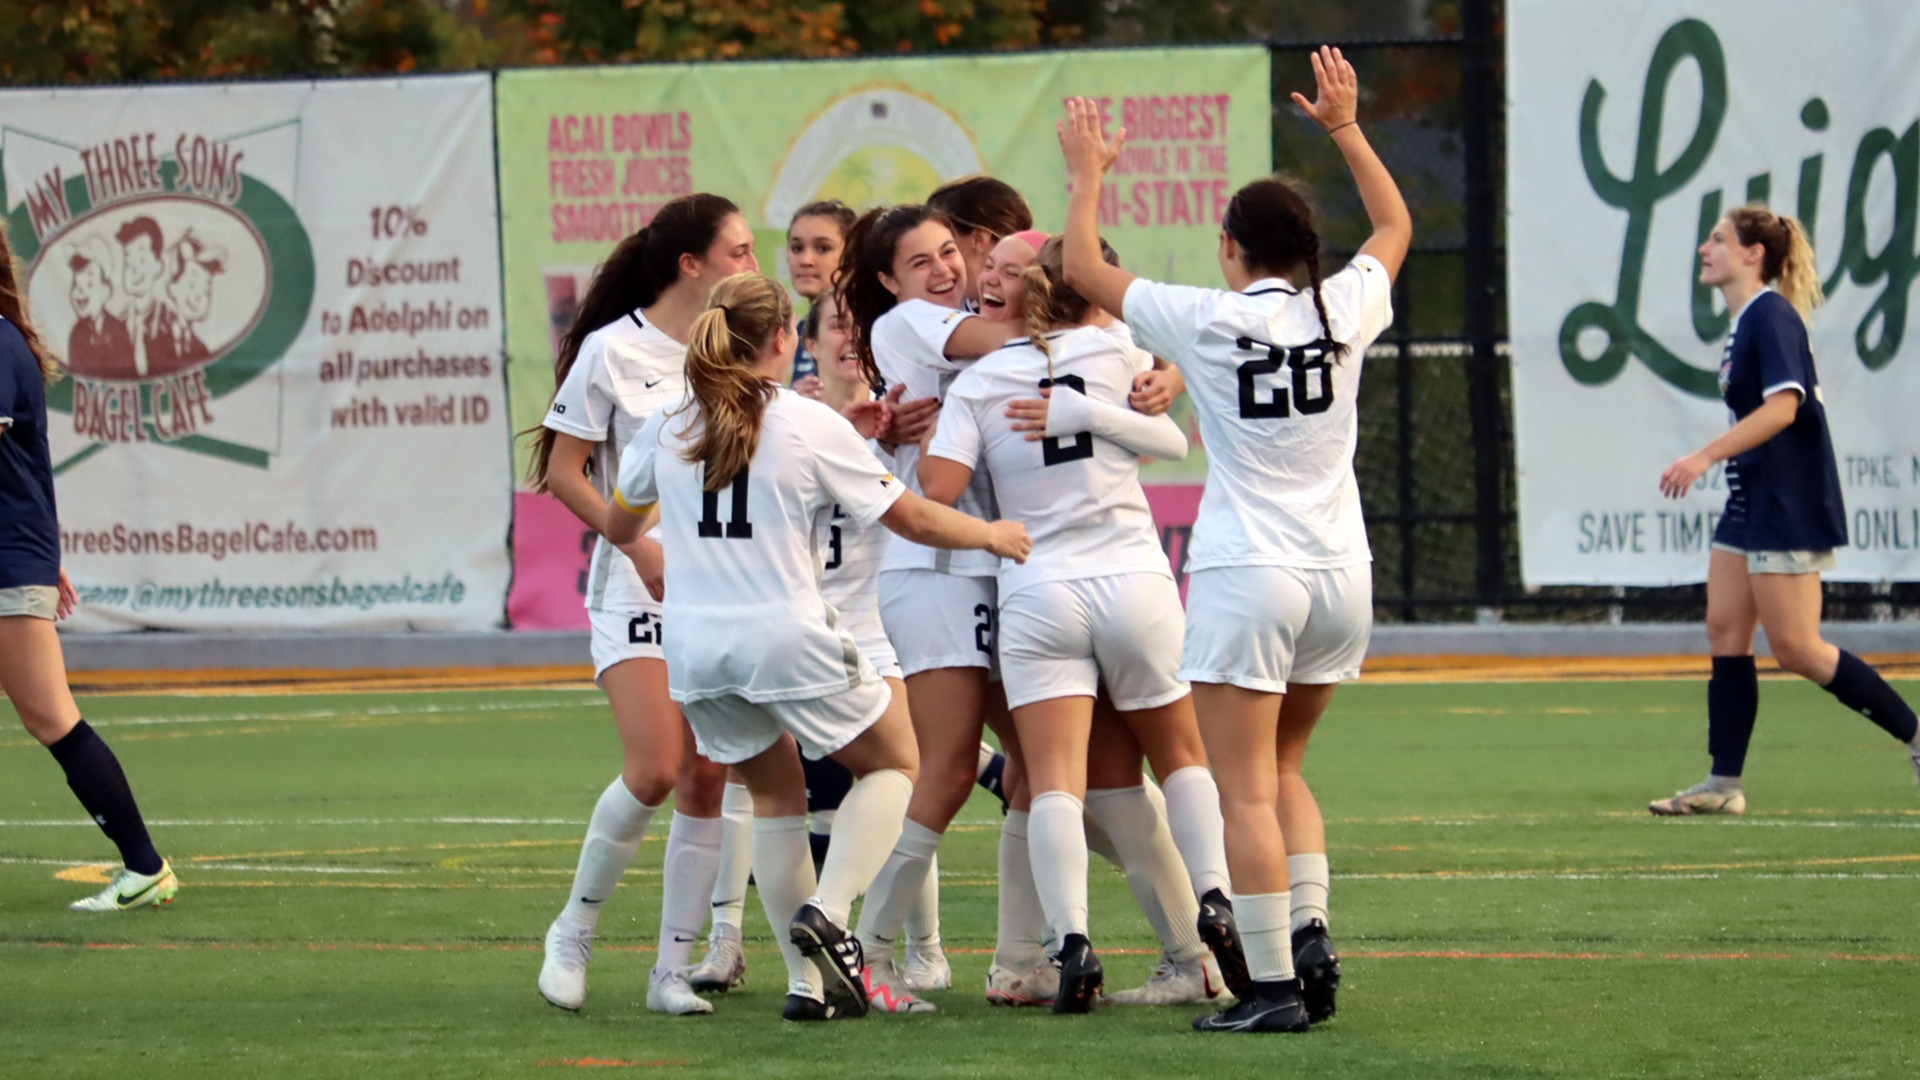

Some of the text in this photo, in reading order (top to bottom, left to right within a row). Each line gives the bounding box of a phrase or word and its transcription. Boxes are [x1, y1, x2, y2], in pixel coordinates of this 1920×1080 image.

[549, 111, 692, 153] ACAI BOWLS
[1121, 95, 1231, 141] BIGGEST
[26, 133, 244, 239] MY THREE SONS
[549, 156, 692, 198] FRESH JUICES
[370, 205, 428, 240] 10%
[346, 257, 460, 289] Discount
[321, 300, 489, 338] to Adelphi on
[319, 348, 492, 388] all purchases
[74, 371, 214, 443] BAGEL CAFE
[330, 395, 489, 428] with valid ID
[697, 460, 753, 539] 11
[58, 520, 378, 561] hreeSonsBagelCafe.com
[1577, 512, 1645, 553] SAVE
